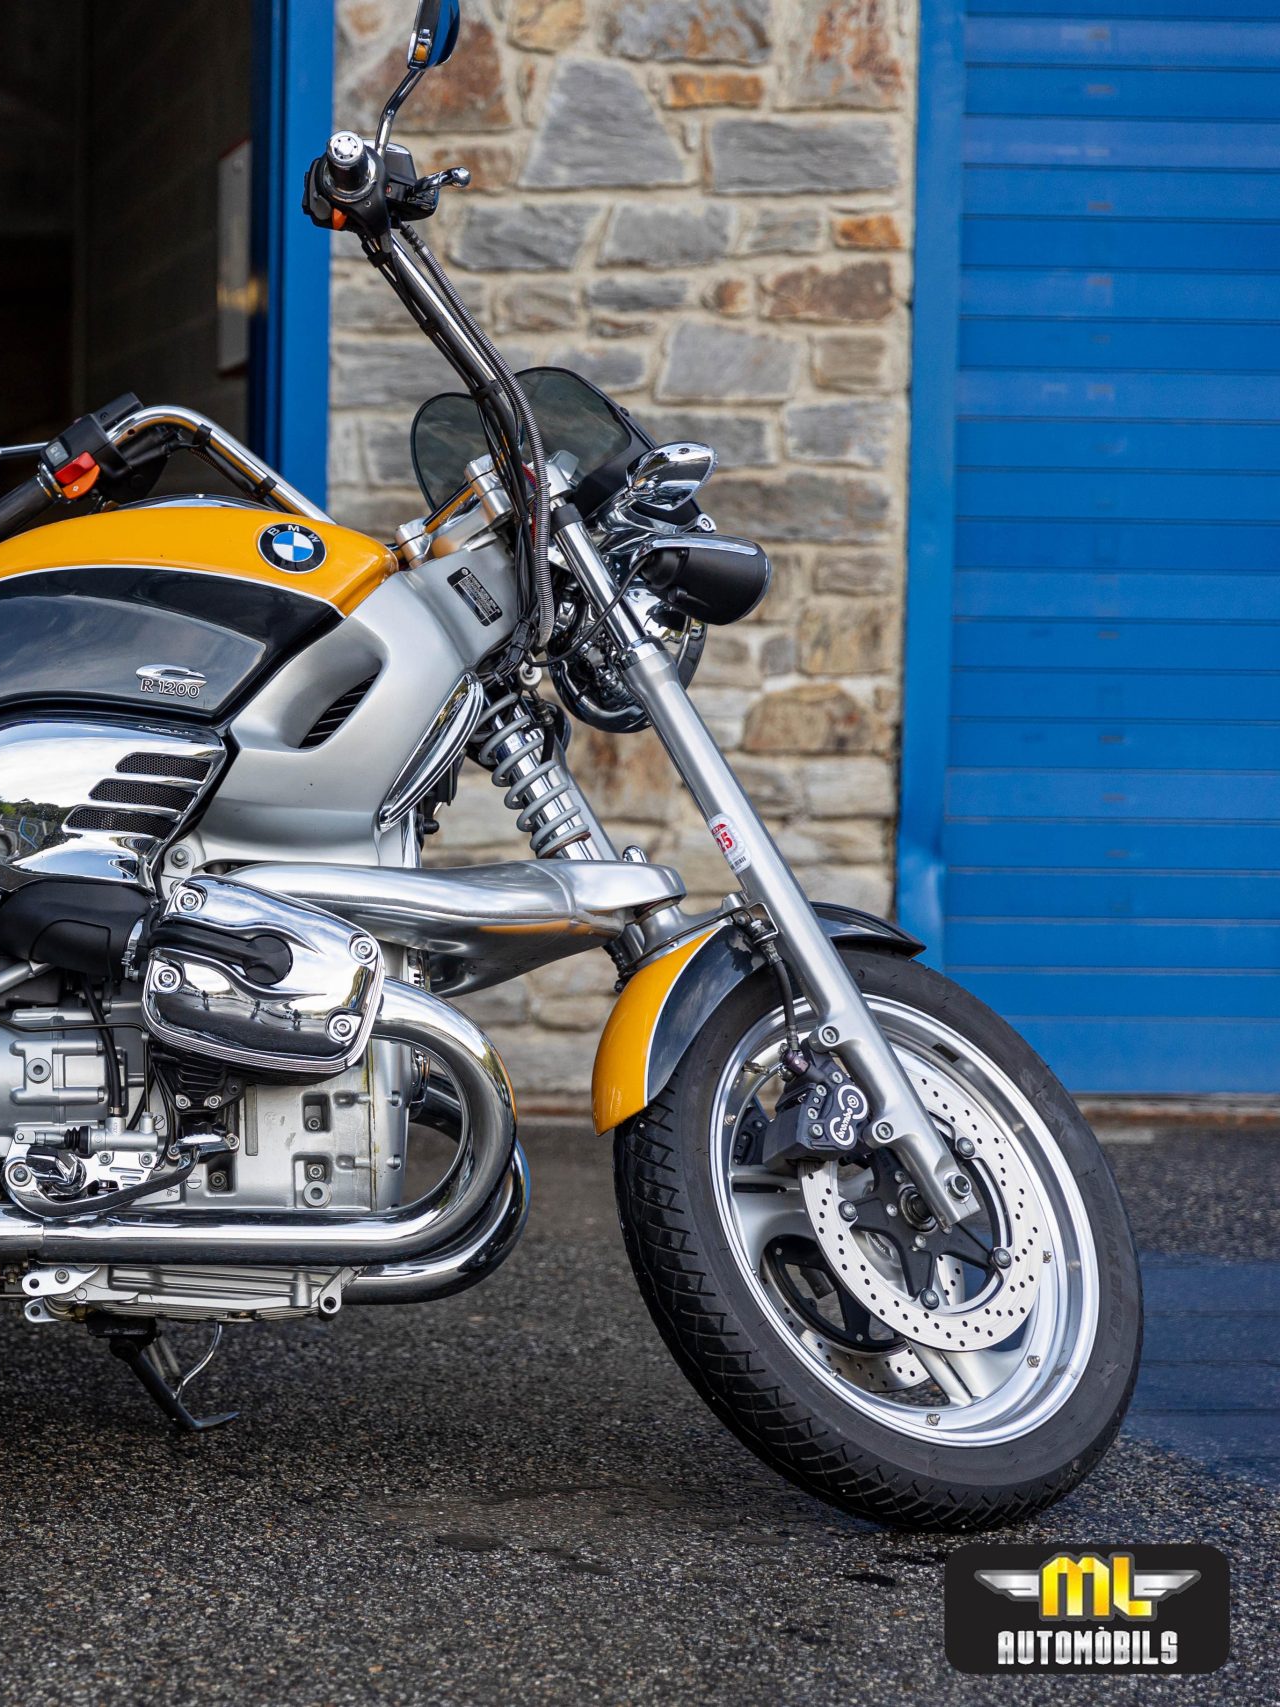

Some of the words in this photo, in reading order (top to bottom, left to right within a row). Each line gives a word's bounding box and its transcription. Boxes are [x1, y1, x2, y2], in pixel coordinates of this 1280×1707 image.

[267, 524, 321, 543] BMW
[140, 678, 154, 693] R
[158, 680, 200, 699] 1200
[836, 1108, 853, 1139] brembo
